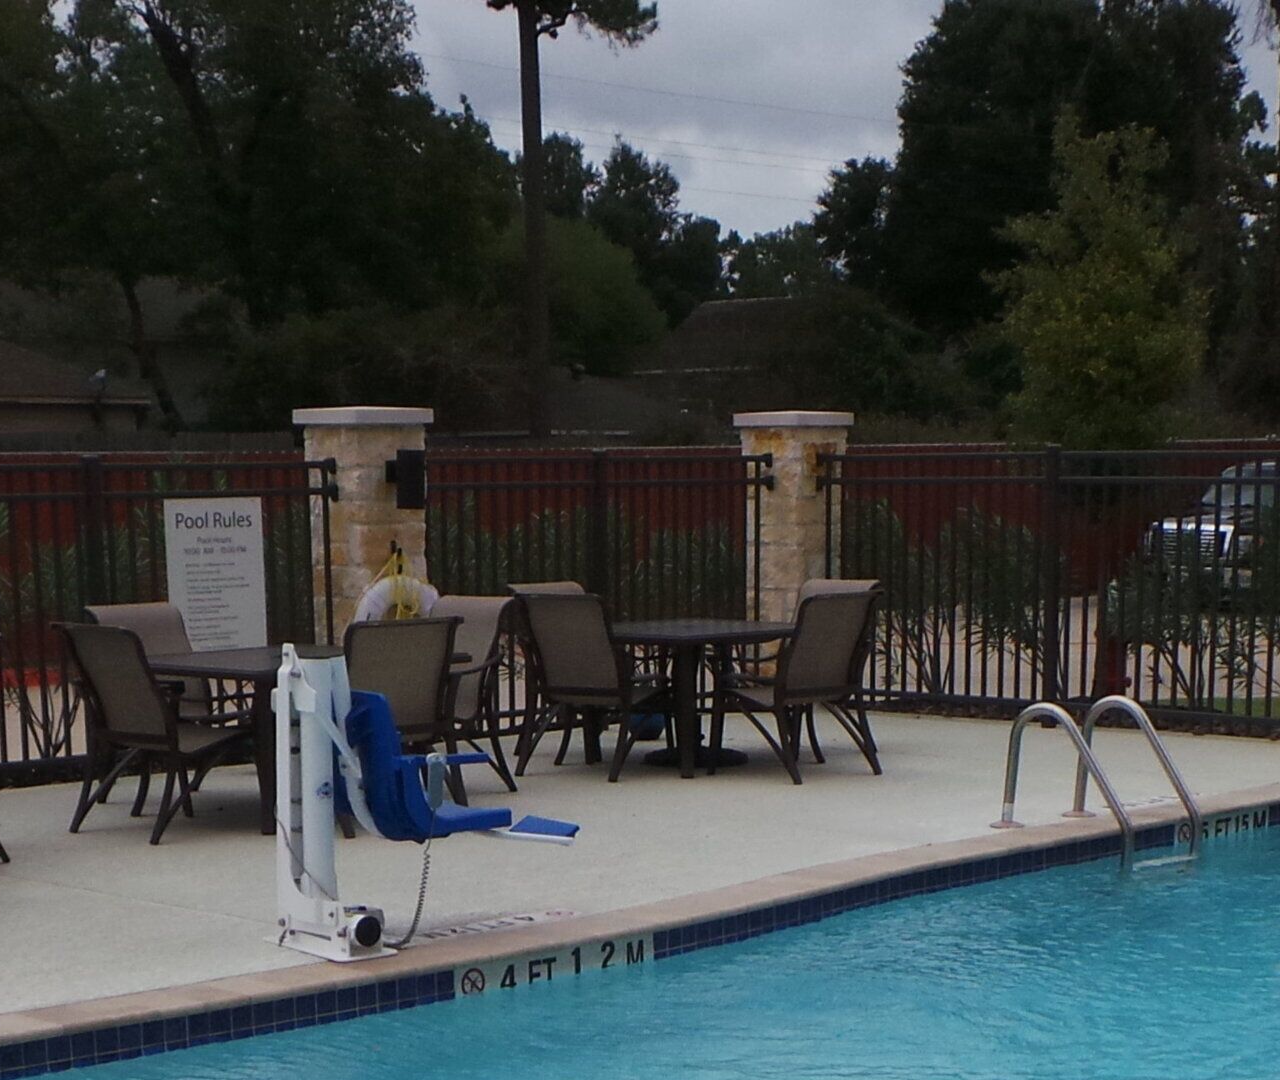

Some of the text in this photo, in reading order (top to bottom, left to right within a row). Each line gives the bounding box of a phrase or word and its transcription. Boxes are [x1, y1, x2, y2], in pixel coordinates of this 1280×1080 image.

[175, 510, 252, 529] Pool Rules
[500, 963, 517, 989] 4
[528, 956, 557, 985] FT
